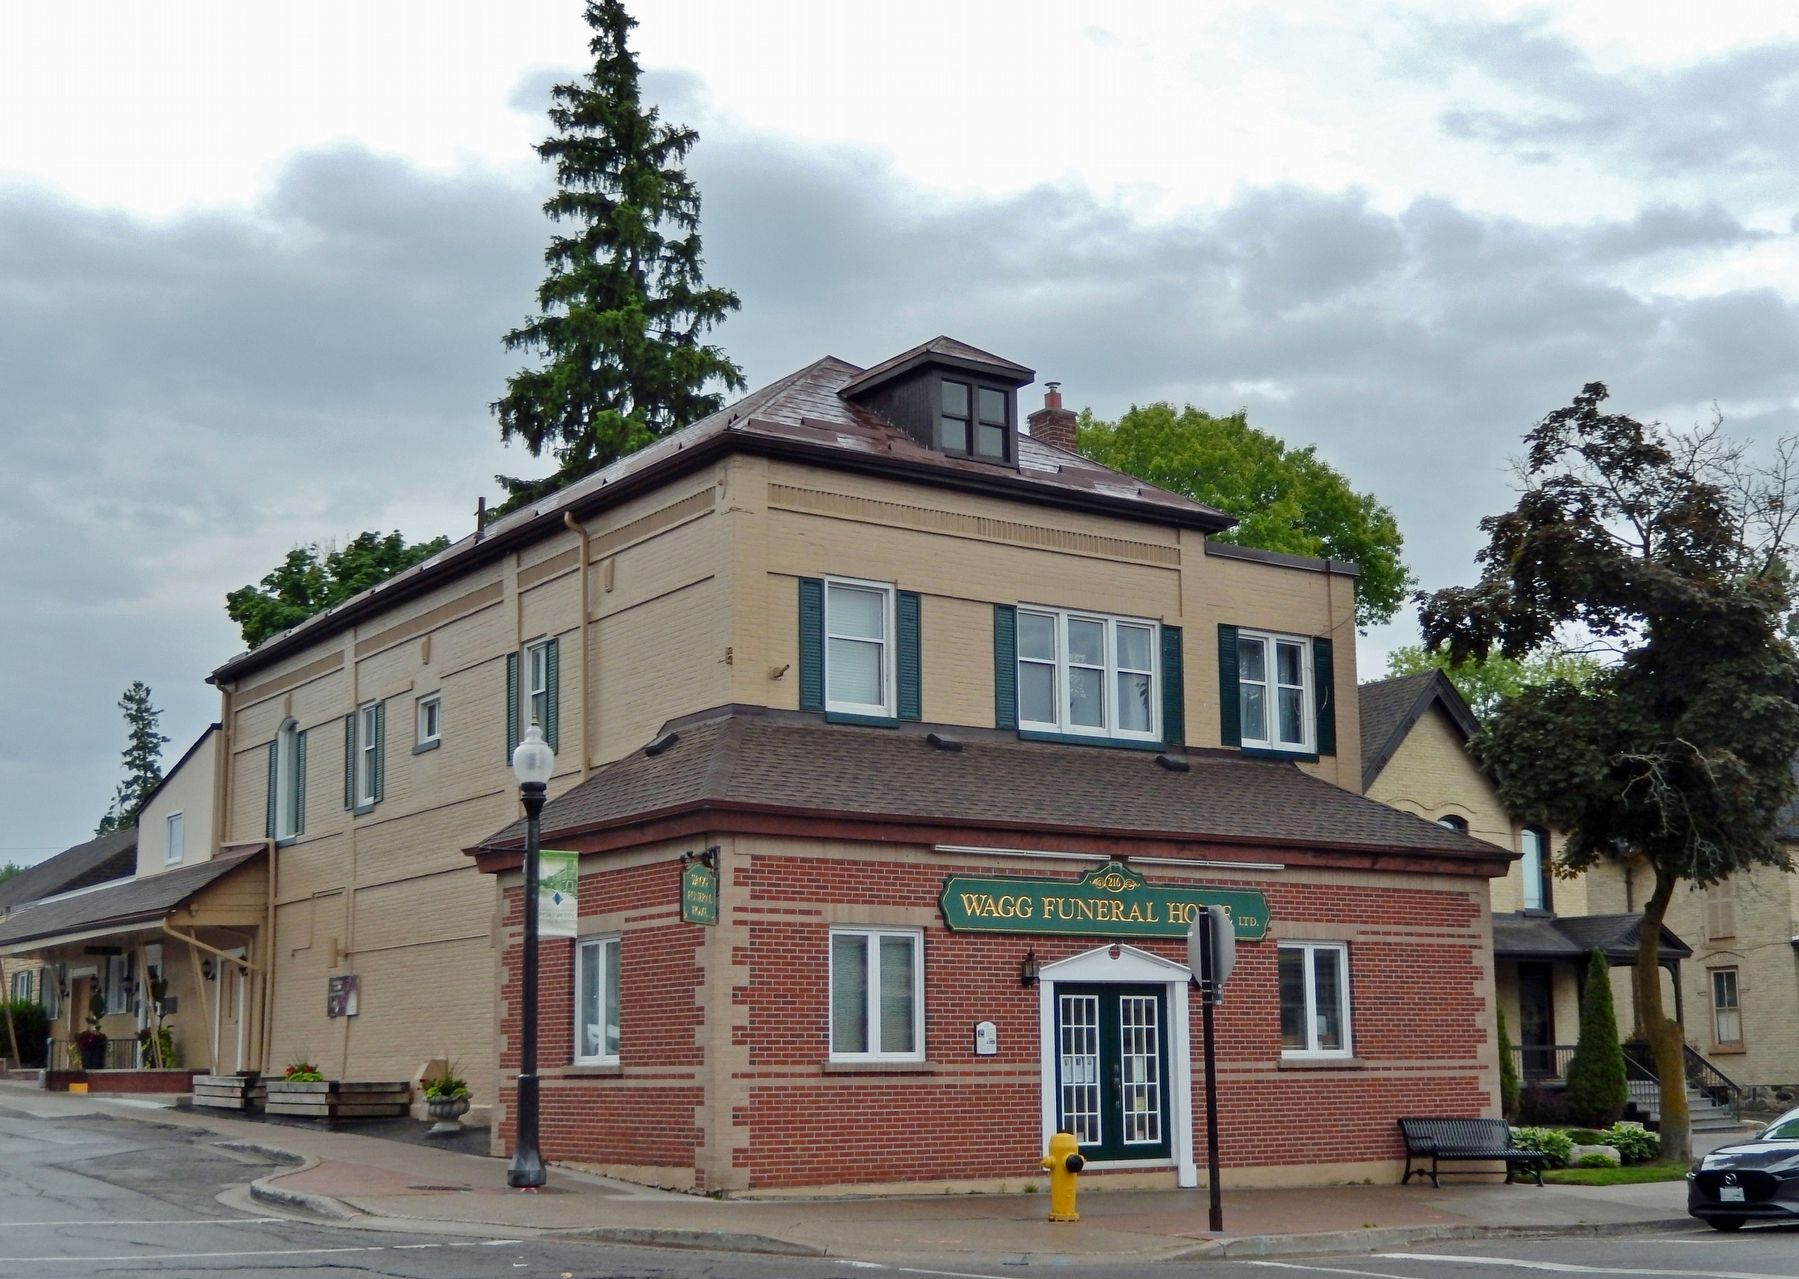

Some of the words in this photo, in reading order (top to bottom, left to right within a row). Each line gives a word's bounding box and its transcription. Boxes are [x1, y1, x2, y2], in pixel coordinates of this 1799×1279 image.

[1107, 877, 1121, 887] 216
[960, 893, 1033, 918] WAGG
[1041, 897, 1160, 922] FUNERAL
[1166, 901, 1233, 925] HOE
[1238, 916, 1260, 928] LTD.
